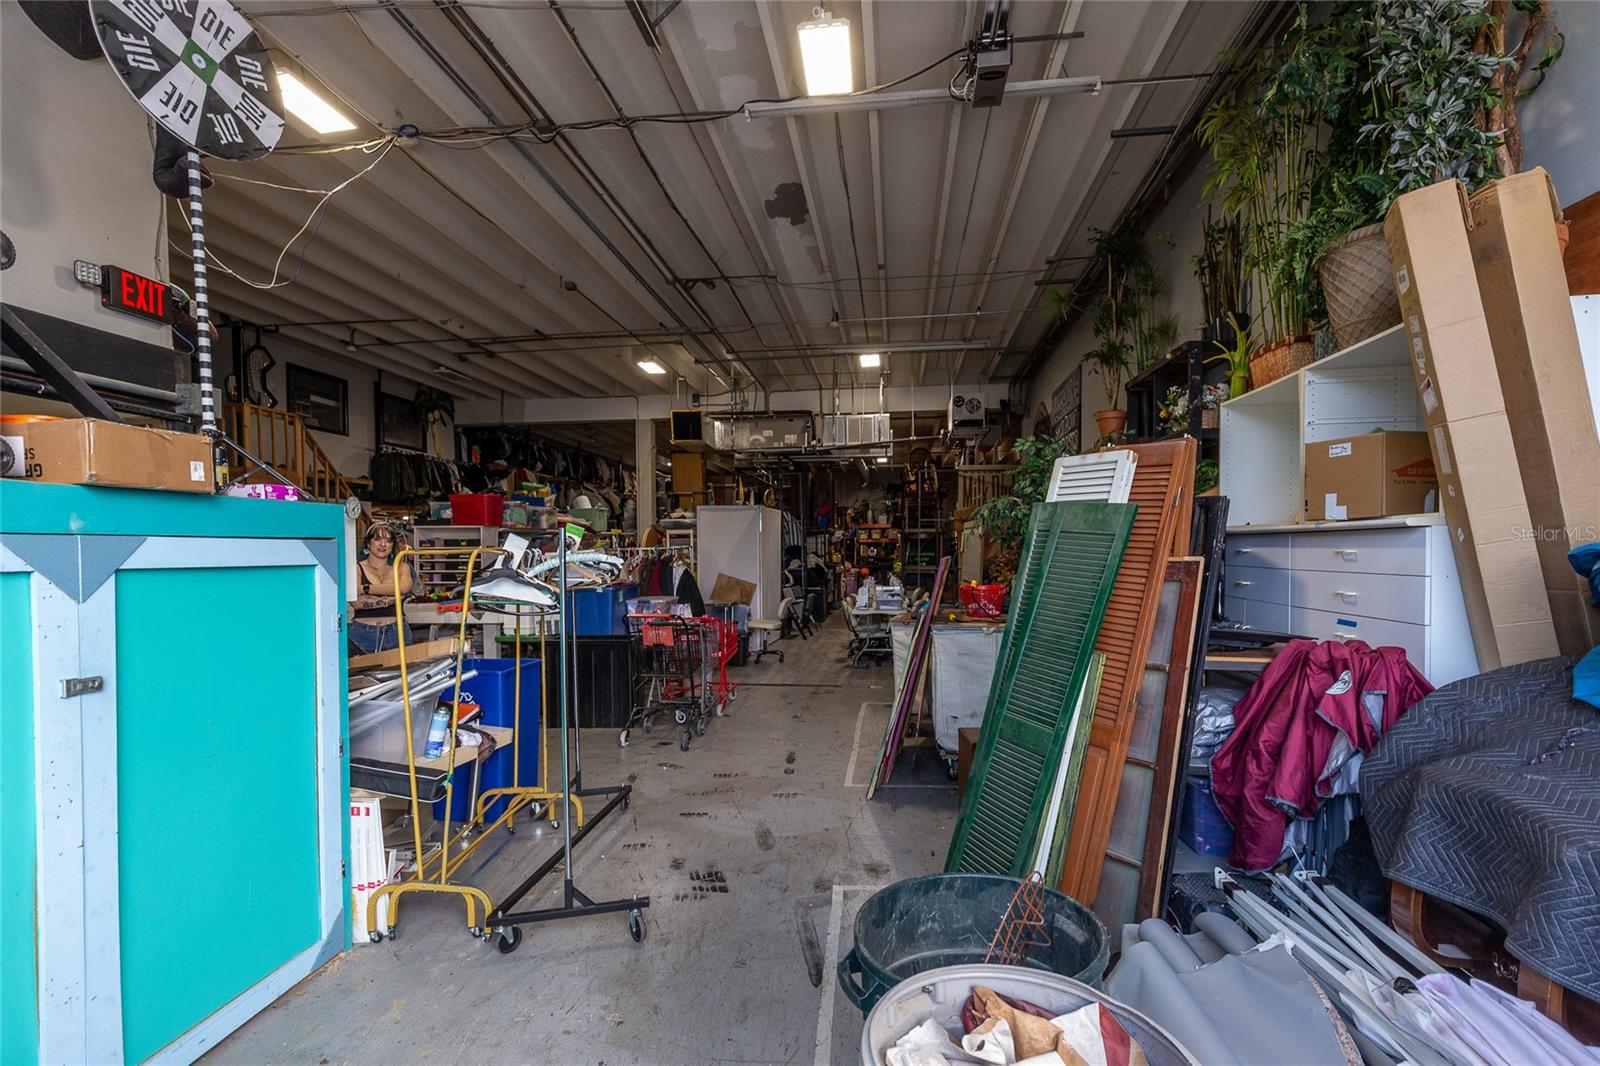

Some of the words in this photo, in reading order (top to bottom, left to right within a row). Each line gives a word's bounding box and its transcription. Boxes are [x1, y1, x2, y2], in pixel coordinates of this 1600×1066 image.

[200, 7, 235, 51] DIE
[115, 30, 161, 73] DIE
[234, 54, 268, 92] DIE
[159, 81, 199, 125] DIE
[234, 92, 267, 131] DIE
[207, 113, 244, 145] DIE
[121, 271, 165, 317] EXIT
